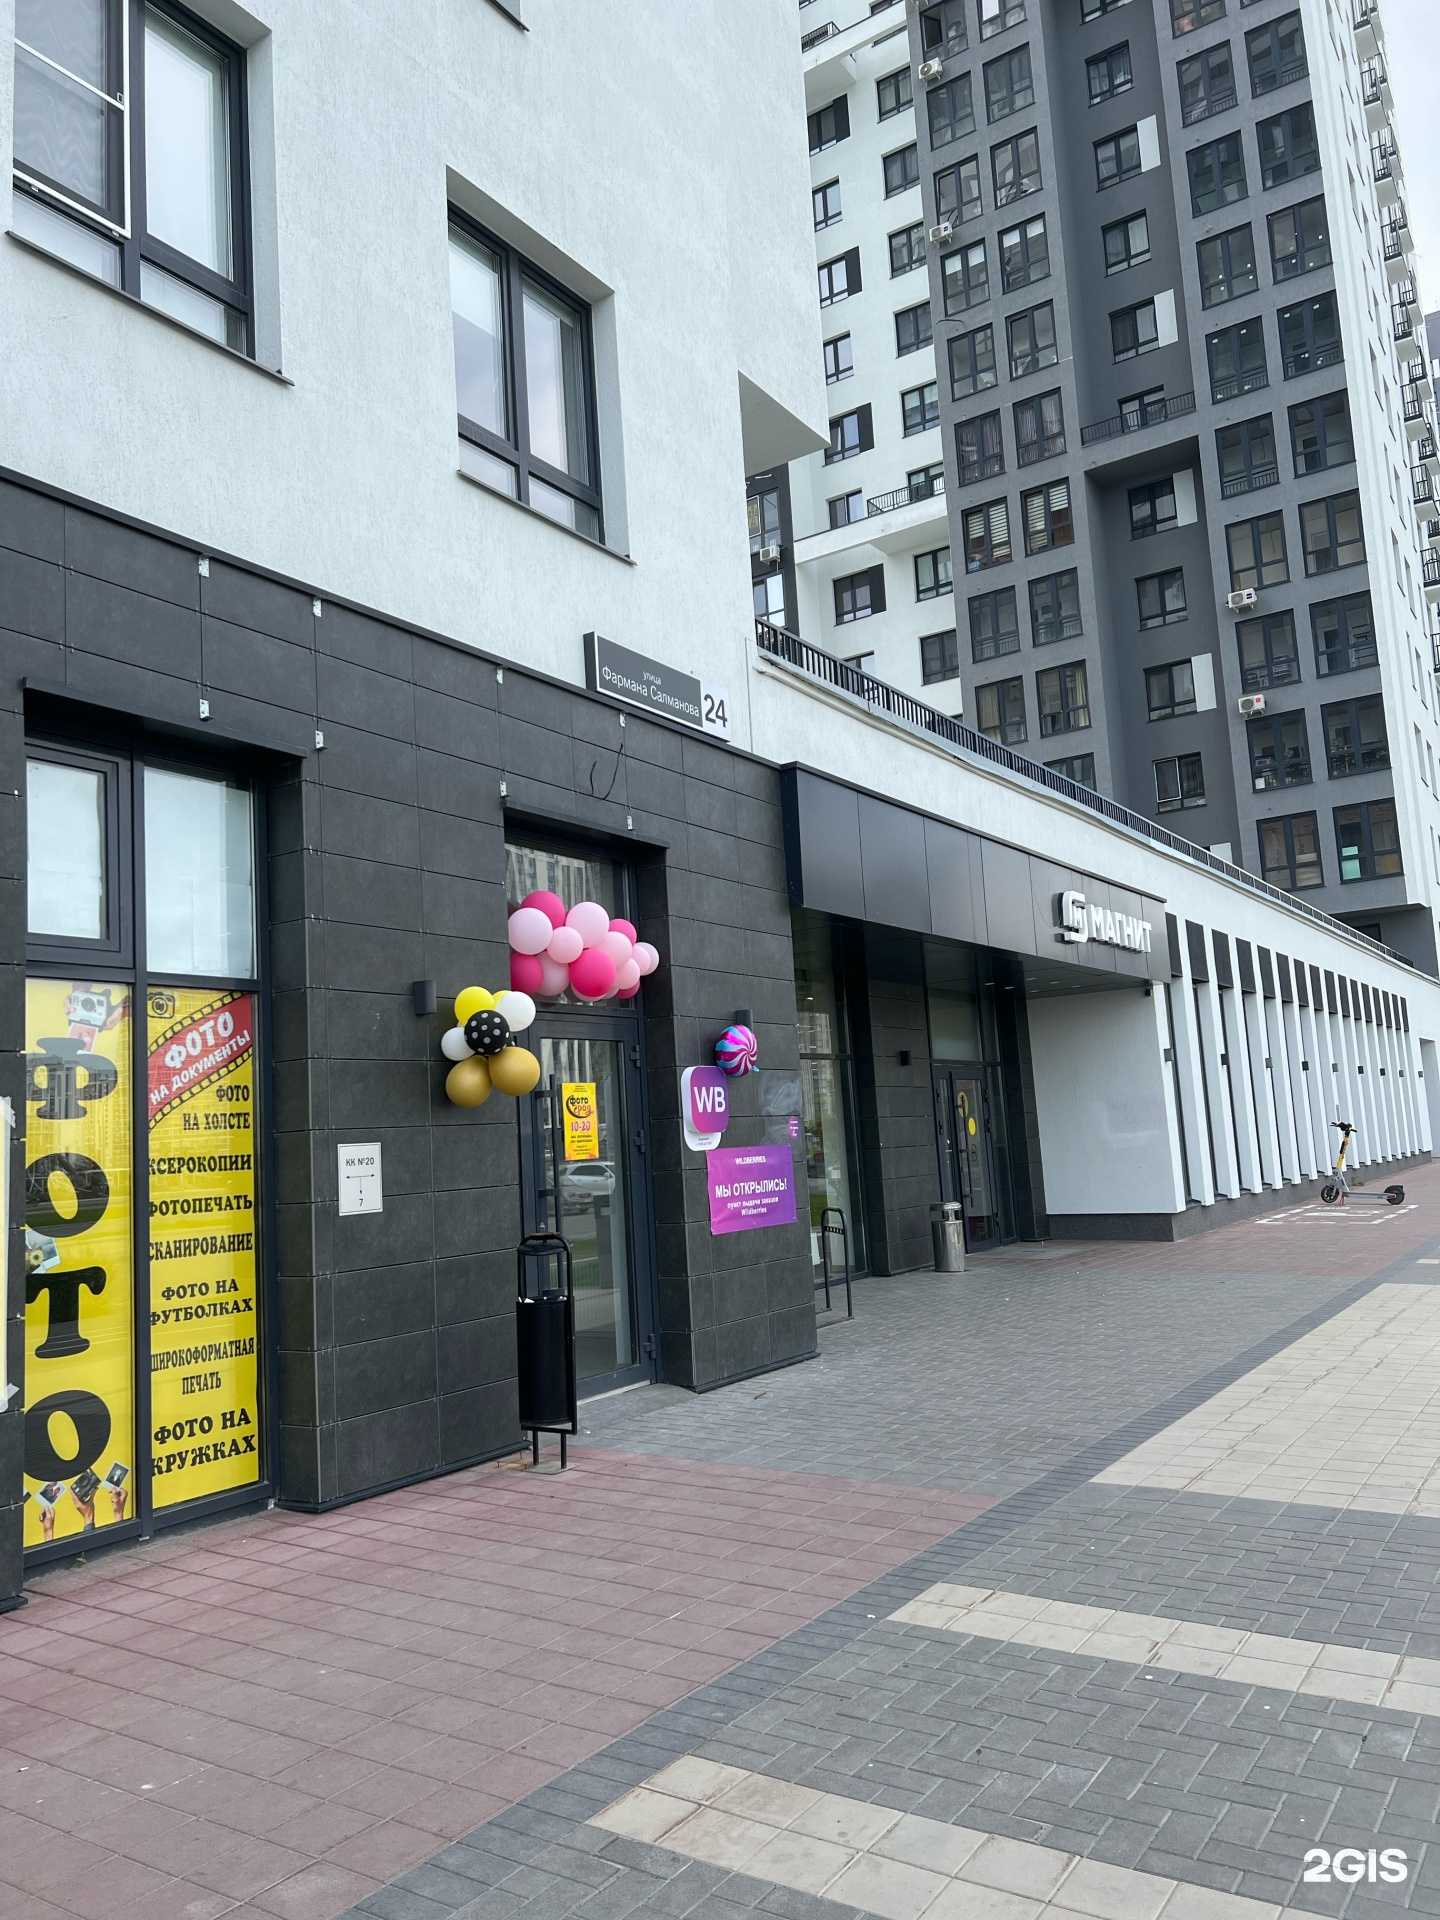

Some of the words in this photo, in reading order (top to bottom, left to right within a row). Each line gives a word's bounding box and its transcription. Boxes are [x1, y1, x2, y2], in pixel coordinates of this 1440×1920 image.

[602, 664, 648, 696] Фармана
[650, 685, 700, 717] Салманова
[703, 693, 728, 728] 24
[1086, 904, 1152, 953] МАГНИТ
[164, 1011, 234, 1069] ФОТО
[150, 1084, 169, 1105] НА
[171, 1029, 251, 1092] ДОКУМЕНТЫ
[216, 1084, 250, 1102] ФОТО
[694, 1086, 726, 1113] WB
[183, 1113, 199, 1131] НА
[204, 1112, 250, 1130] ХОЛСТЕ
[345, 1157, 356, 1167] КК
[358, 1157, 375, 1166] №20
[715, 1183, 732, 1199] МЫ
[733, 1178, 788, 1196] ОТКРЫЛИСЬ!
[359, 1198, 364, 1207] 7
[161, 1282, 210, 1300] ФОТО
[216, 1279, 239, 1294] НА
[182, 1371, 221, 1395] ПЕЧАТЬ
[154, 1415, 213, 1445] ФОТО
[221, 1408, 251, 1430] НА
[152, 1434, 256, 1477] КРУЖКАХ
